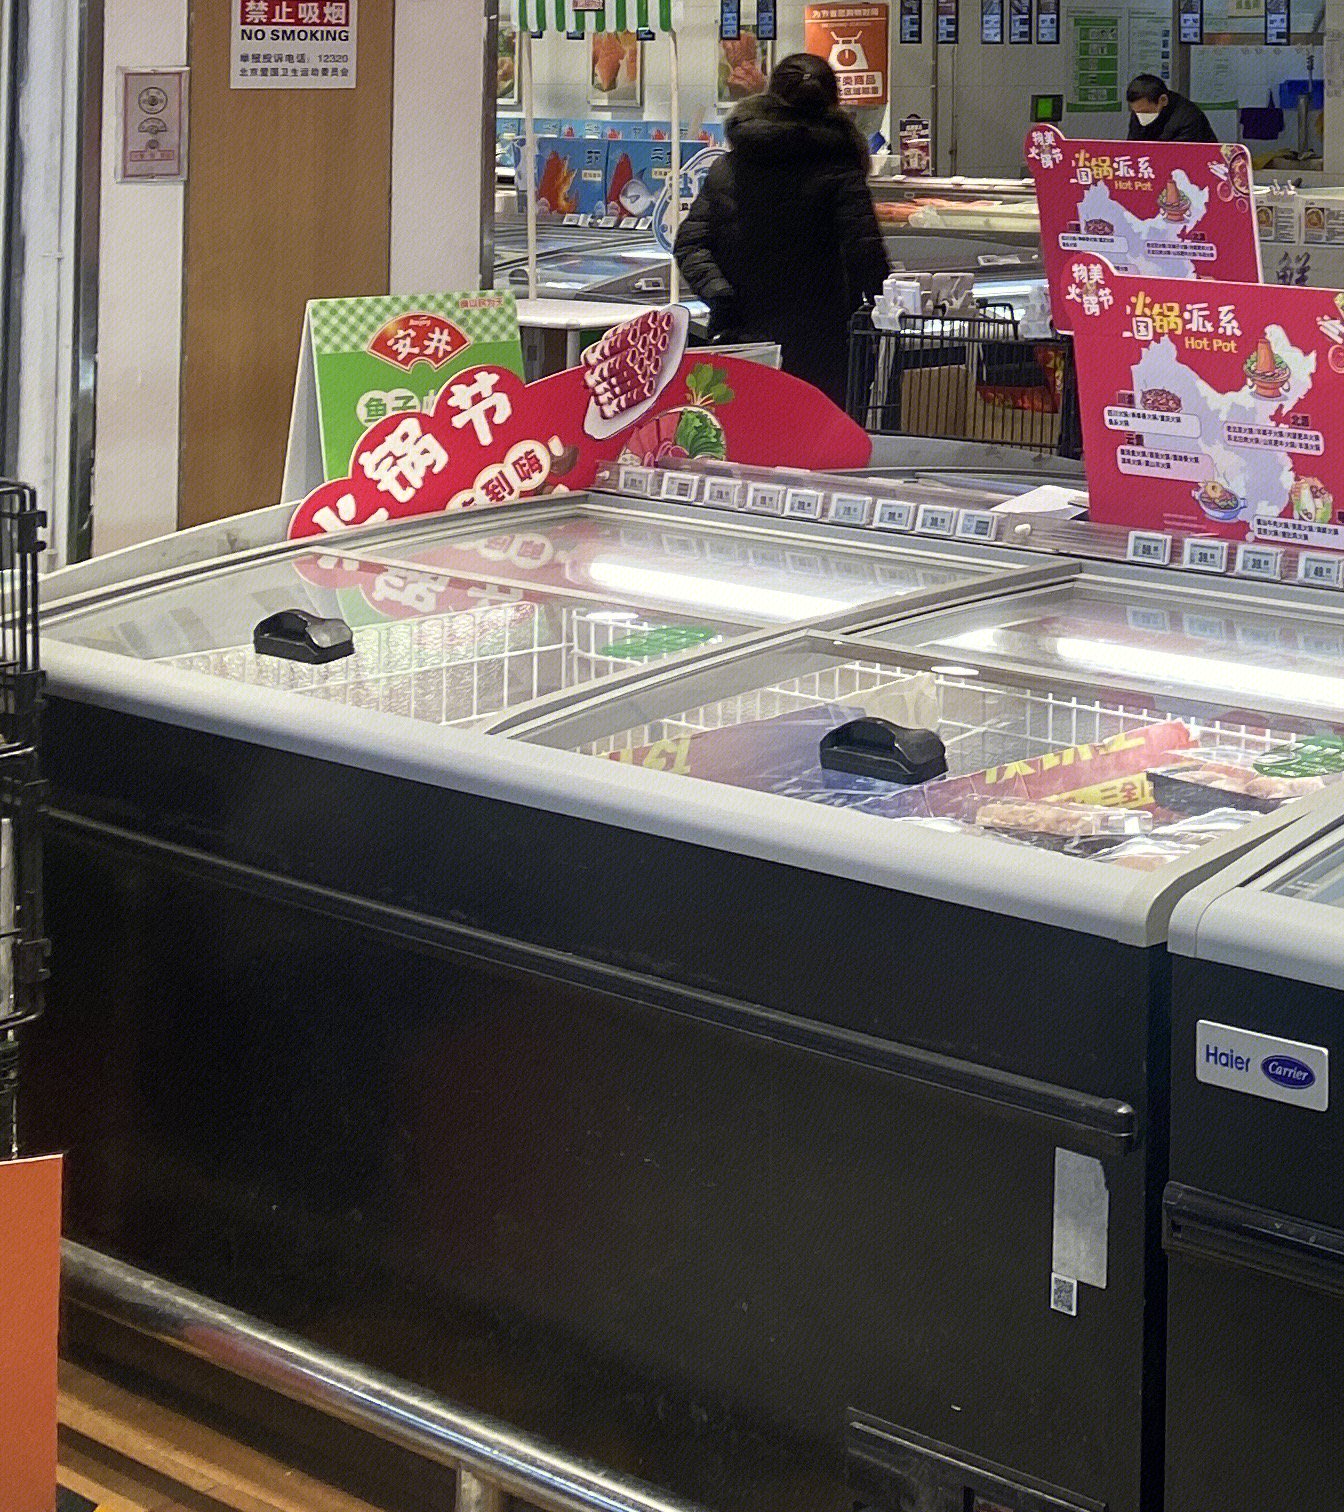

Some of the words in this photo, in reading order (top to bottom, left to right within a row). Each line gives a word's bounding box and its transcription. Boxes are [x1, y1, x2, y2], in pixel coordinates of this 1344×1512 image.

[244, 0, 346, 24] 禁止吸烟
[241, 29, 265, 41] NO
[270, 29, 349, 41] SMOKING
[318, 54, 348, 63] 12320
[1072, 262, 1105, 285] 物美
[1065, 284, 1115, 316] 火锅节
[386, 327, 452, 361] 安井
[1185, 337, 1211, 351] Hot
[1213, 338, 1239, 353] Pot
[1205, 1044, 1251, 1073] Haier
[1267, 1061, 1309, 1081] Carrier
